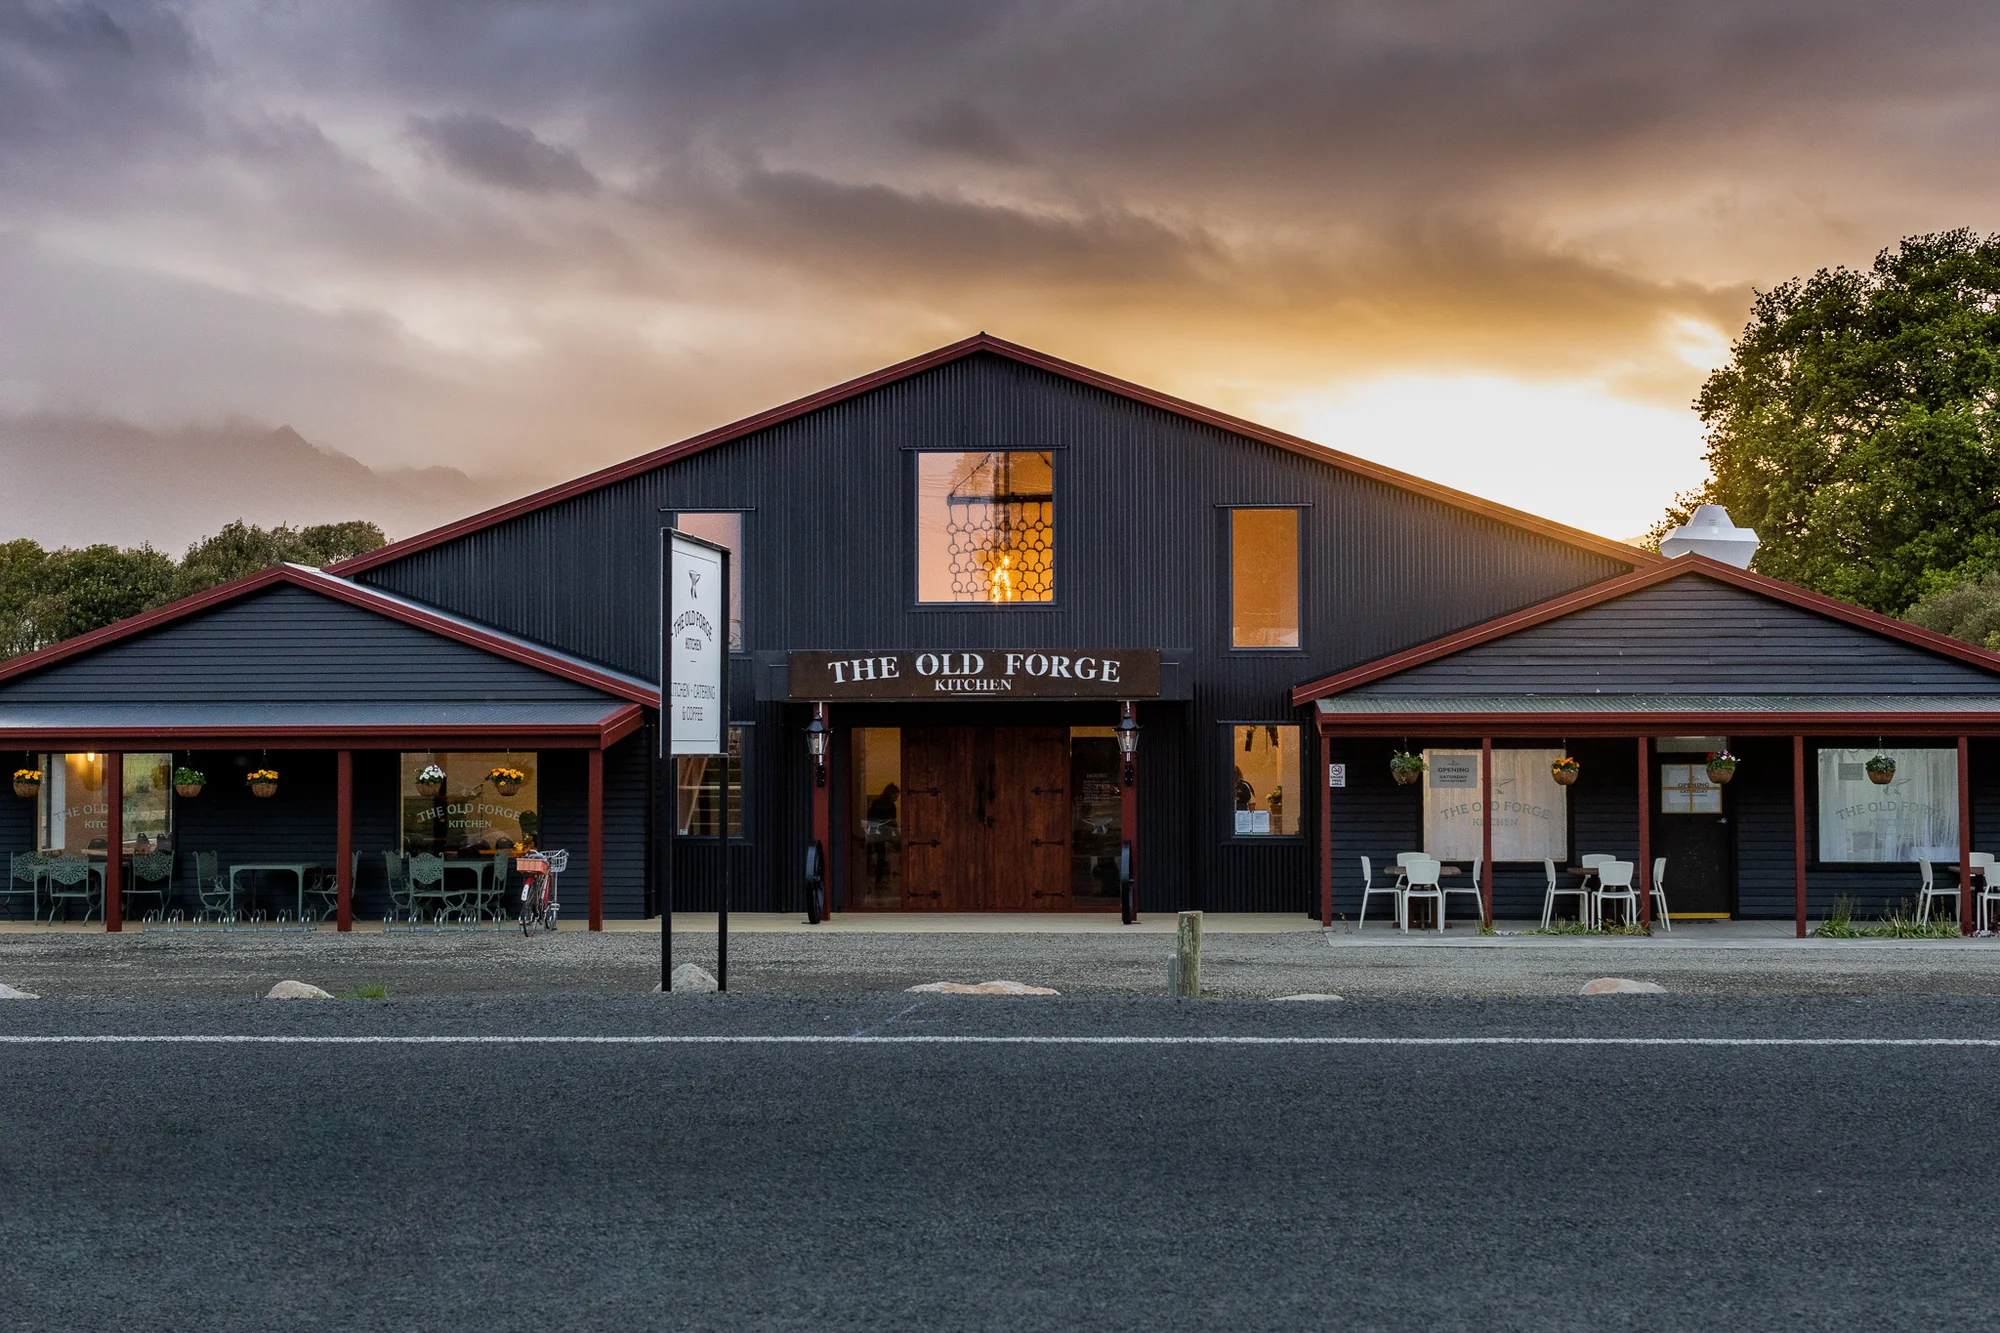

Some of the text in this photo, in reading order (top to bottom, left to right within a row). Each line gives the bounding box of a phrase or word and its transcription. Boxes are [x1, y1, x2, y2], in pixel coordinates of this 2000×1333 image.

[674, 610, 713, 642] THE OLD FORGE
[685, 637, 702, 651] KITCHEN
[828, 653, 1121, 684] THE OLD FORGE
[671, 682, 716, 699] ITCHEN CATERING
[934, 678, 1013, 692] KITCHEN
[682, 705, 703, 721] & COFFEE
[53, 807, 81, 822] THE
[417, 803, 522, 822] THE OLD FORGE
[1441, 801, 1551, 820] THE OD FORGE
[1835, 804, 1865, 820] THE
[1868, 801, 1897, 813] OLD
[448, 820, 492, 828] KITCHEN
[1472, 818, 1519, 826] KICHEN
